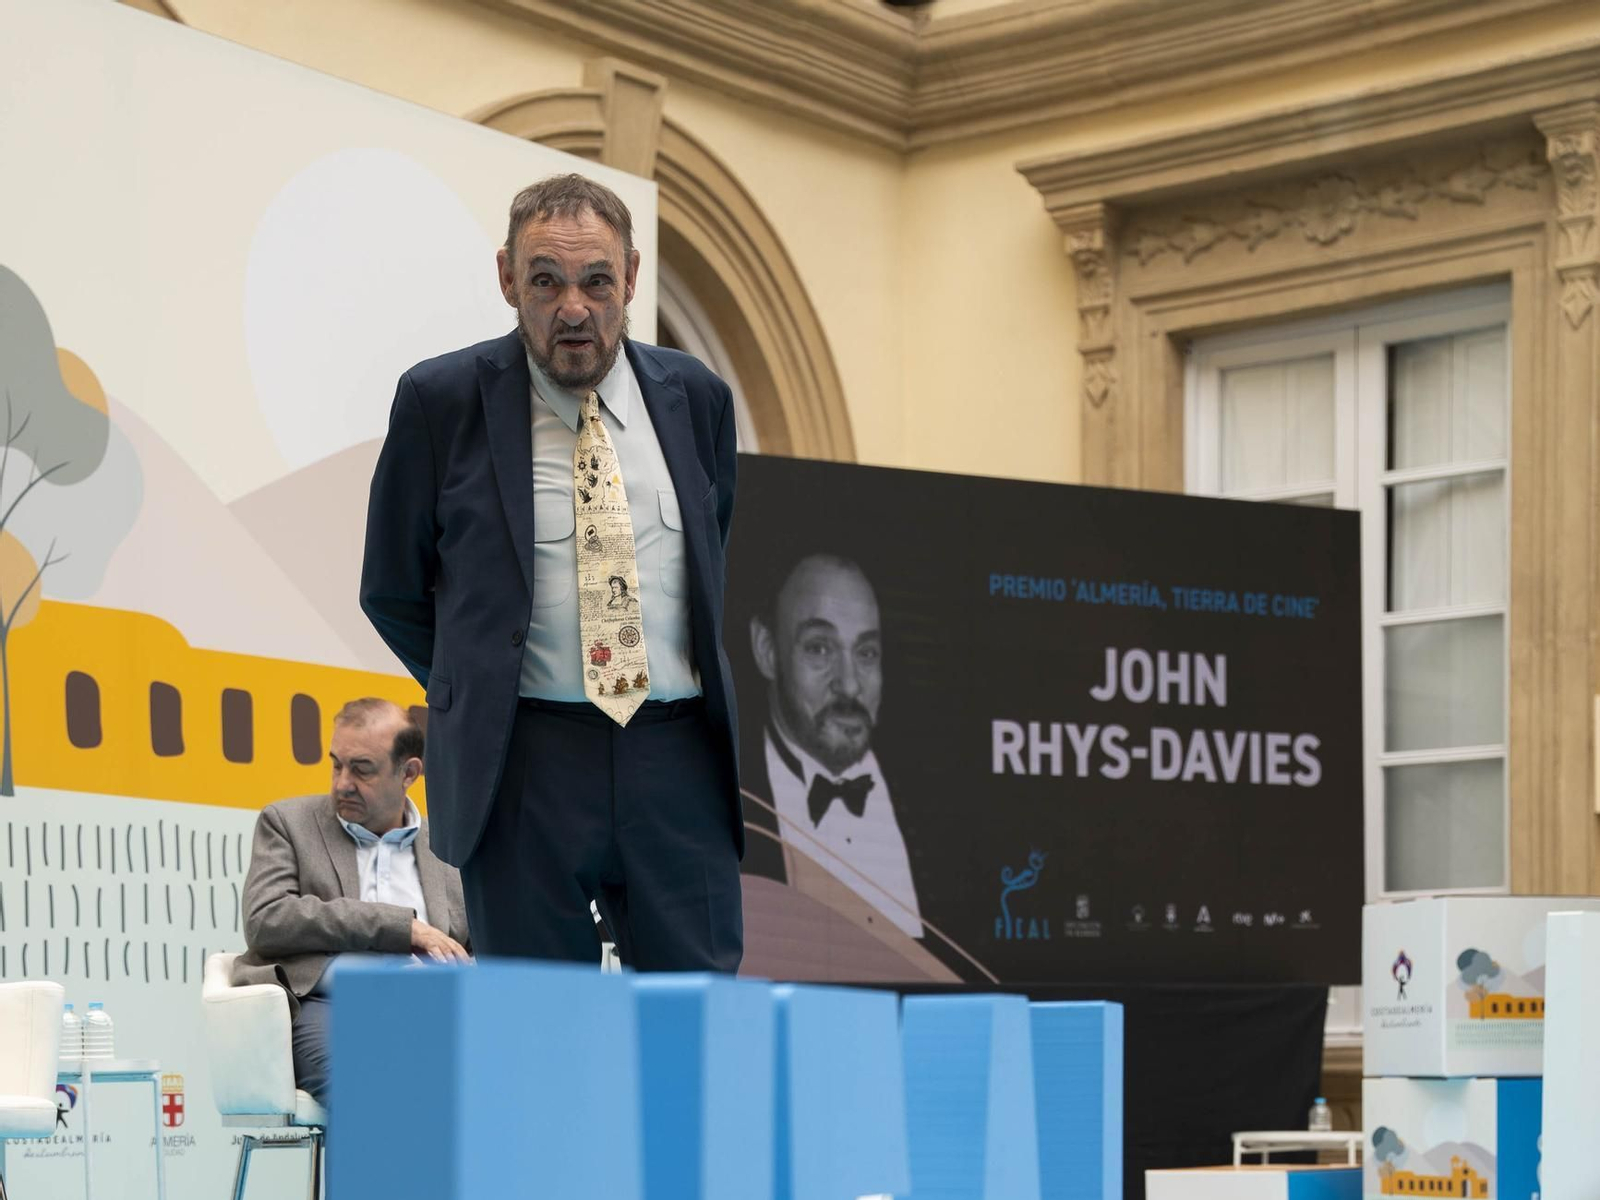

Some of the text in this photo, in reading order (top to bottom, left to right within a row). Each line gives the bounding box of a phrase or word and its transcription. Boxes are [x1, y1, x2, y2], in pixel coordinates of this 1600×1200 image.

[989, 573, 1067, 600] PREMIO
[1171, 586, 1240, 614] TIERRA
[1243, 592, 1268, 616] DE
[1089, 647, 1228, 707] JOHN
[991, 719, 1323, 788] RHYS-DAVIES
[150, 1133, 196, 1148] AMERÍA
